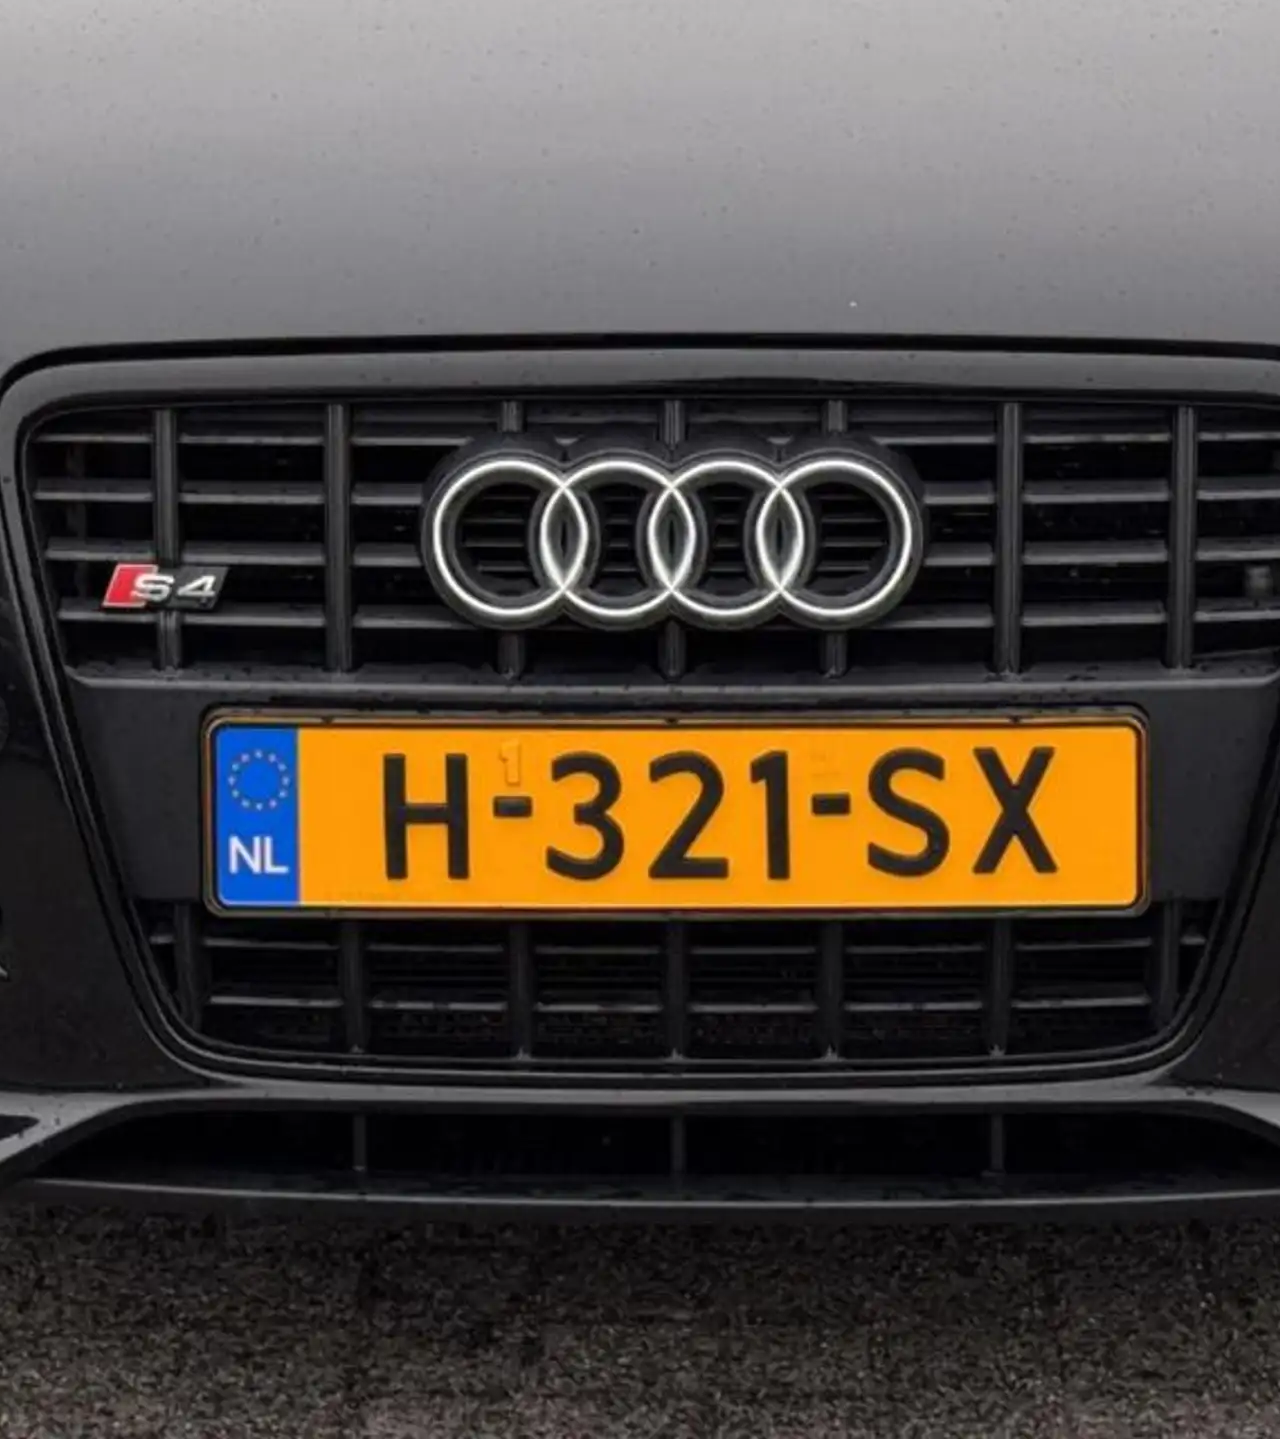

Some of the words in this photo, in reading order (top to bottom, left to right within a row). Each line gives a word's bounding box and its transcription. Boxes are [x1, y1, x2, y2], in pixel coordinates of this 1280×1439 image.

[130, 573, 217, 606] S4
[382, 747, 1058, 881] H-321-SX
[228, 835, 289, 874] NL
